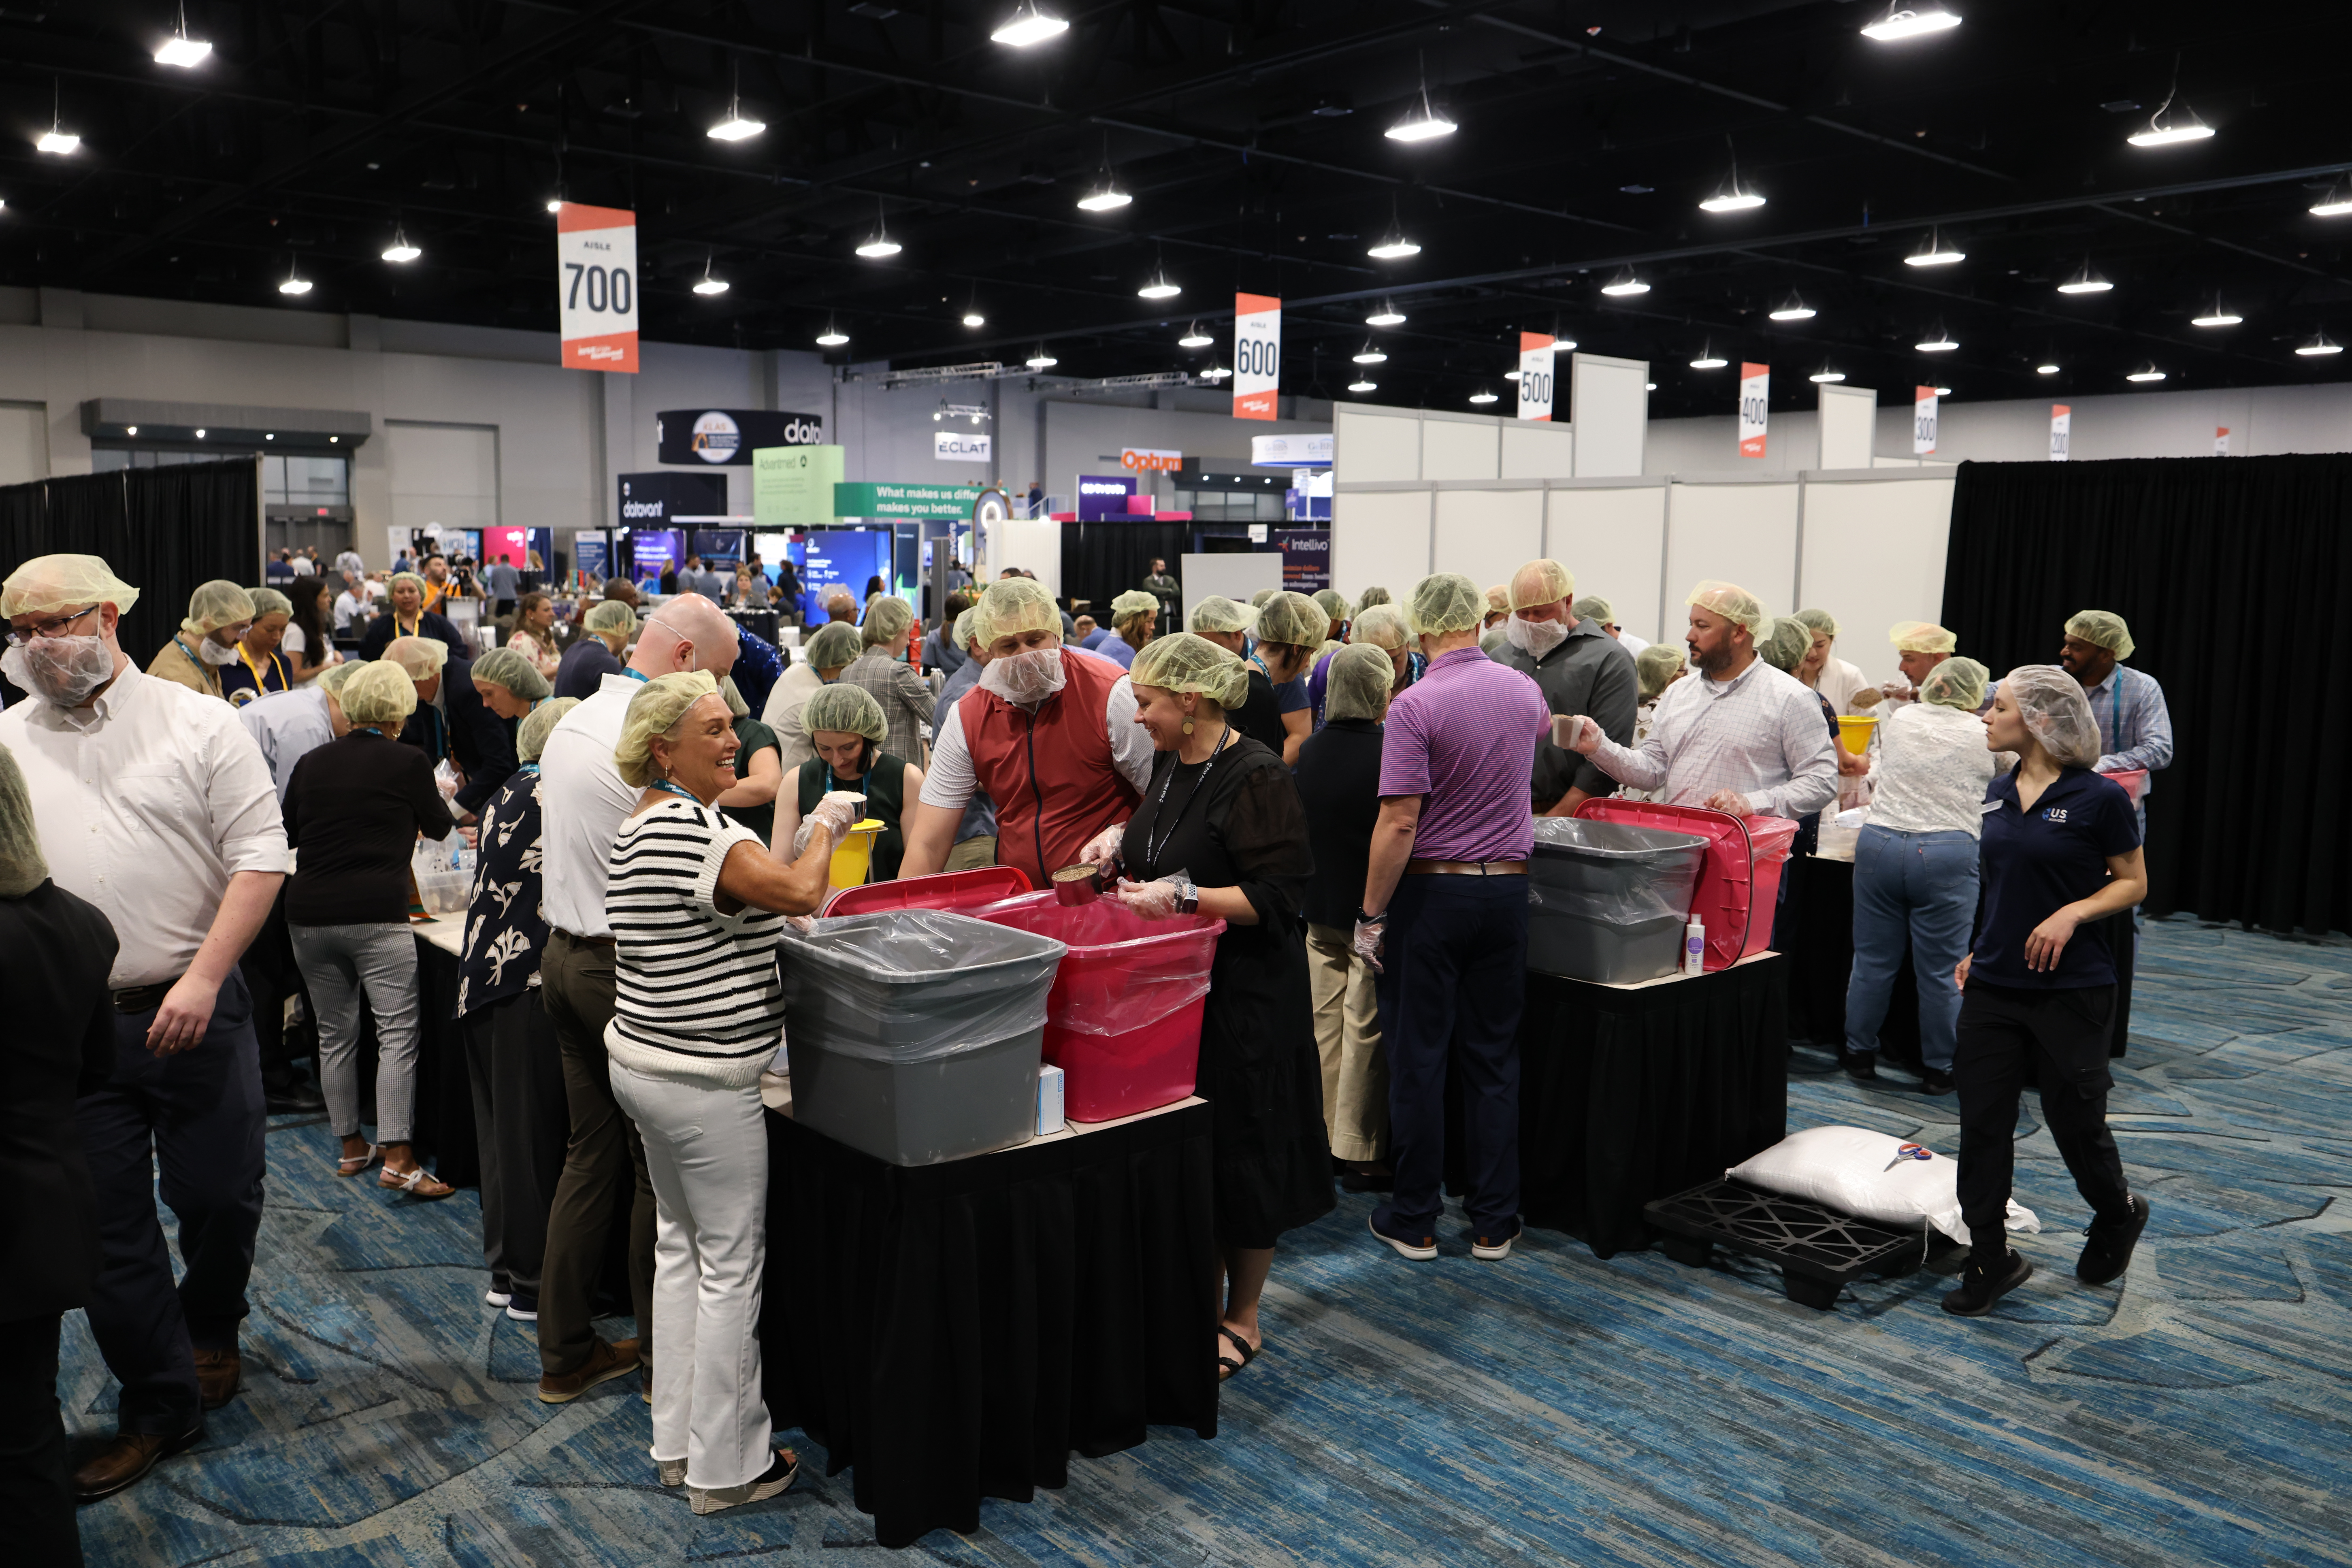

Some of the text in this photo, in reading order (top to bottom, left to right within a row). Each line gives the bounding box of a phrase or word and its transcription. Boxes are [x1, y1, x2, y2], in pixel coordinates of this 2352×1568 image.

[584, 241, 611, 251] AISLE
[565, 262, 631, 314] 700
[1239, 337, 1276, 376] 600
[1522, 371, 1550, 403] 500
[1743, 396, 1766, 424] 400
[1916, 417, 1935, 441] 300
[939, 441, 987, 453] ECLAT
[1121, 451, 1182, 474] Optum
[876, 486, 981, 501] What makes us differ
[623, 500, 663, 518] datavant
[876, 502, 963, 516] makes you better.
[1291, 538, 1328, 551] Intellivo
[1214, 742, 1224, 755] Cowboy
[1164, 770, 1174, 790] Adjustment
[1191, 775, 1205, 795] Adjustment
[671, 788, 692, 796] National
